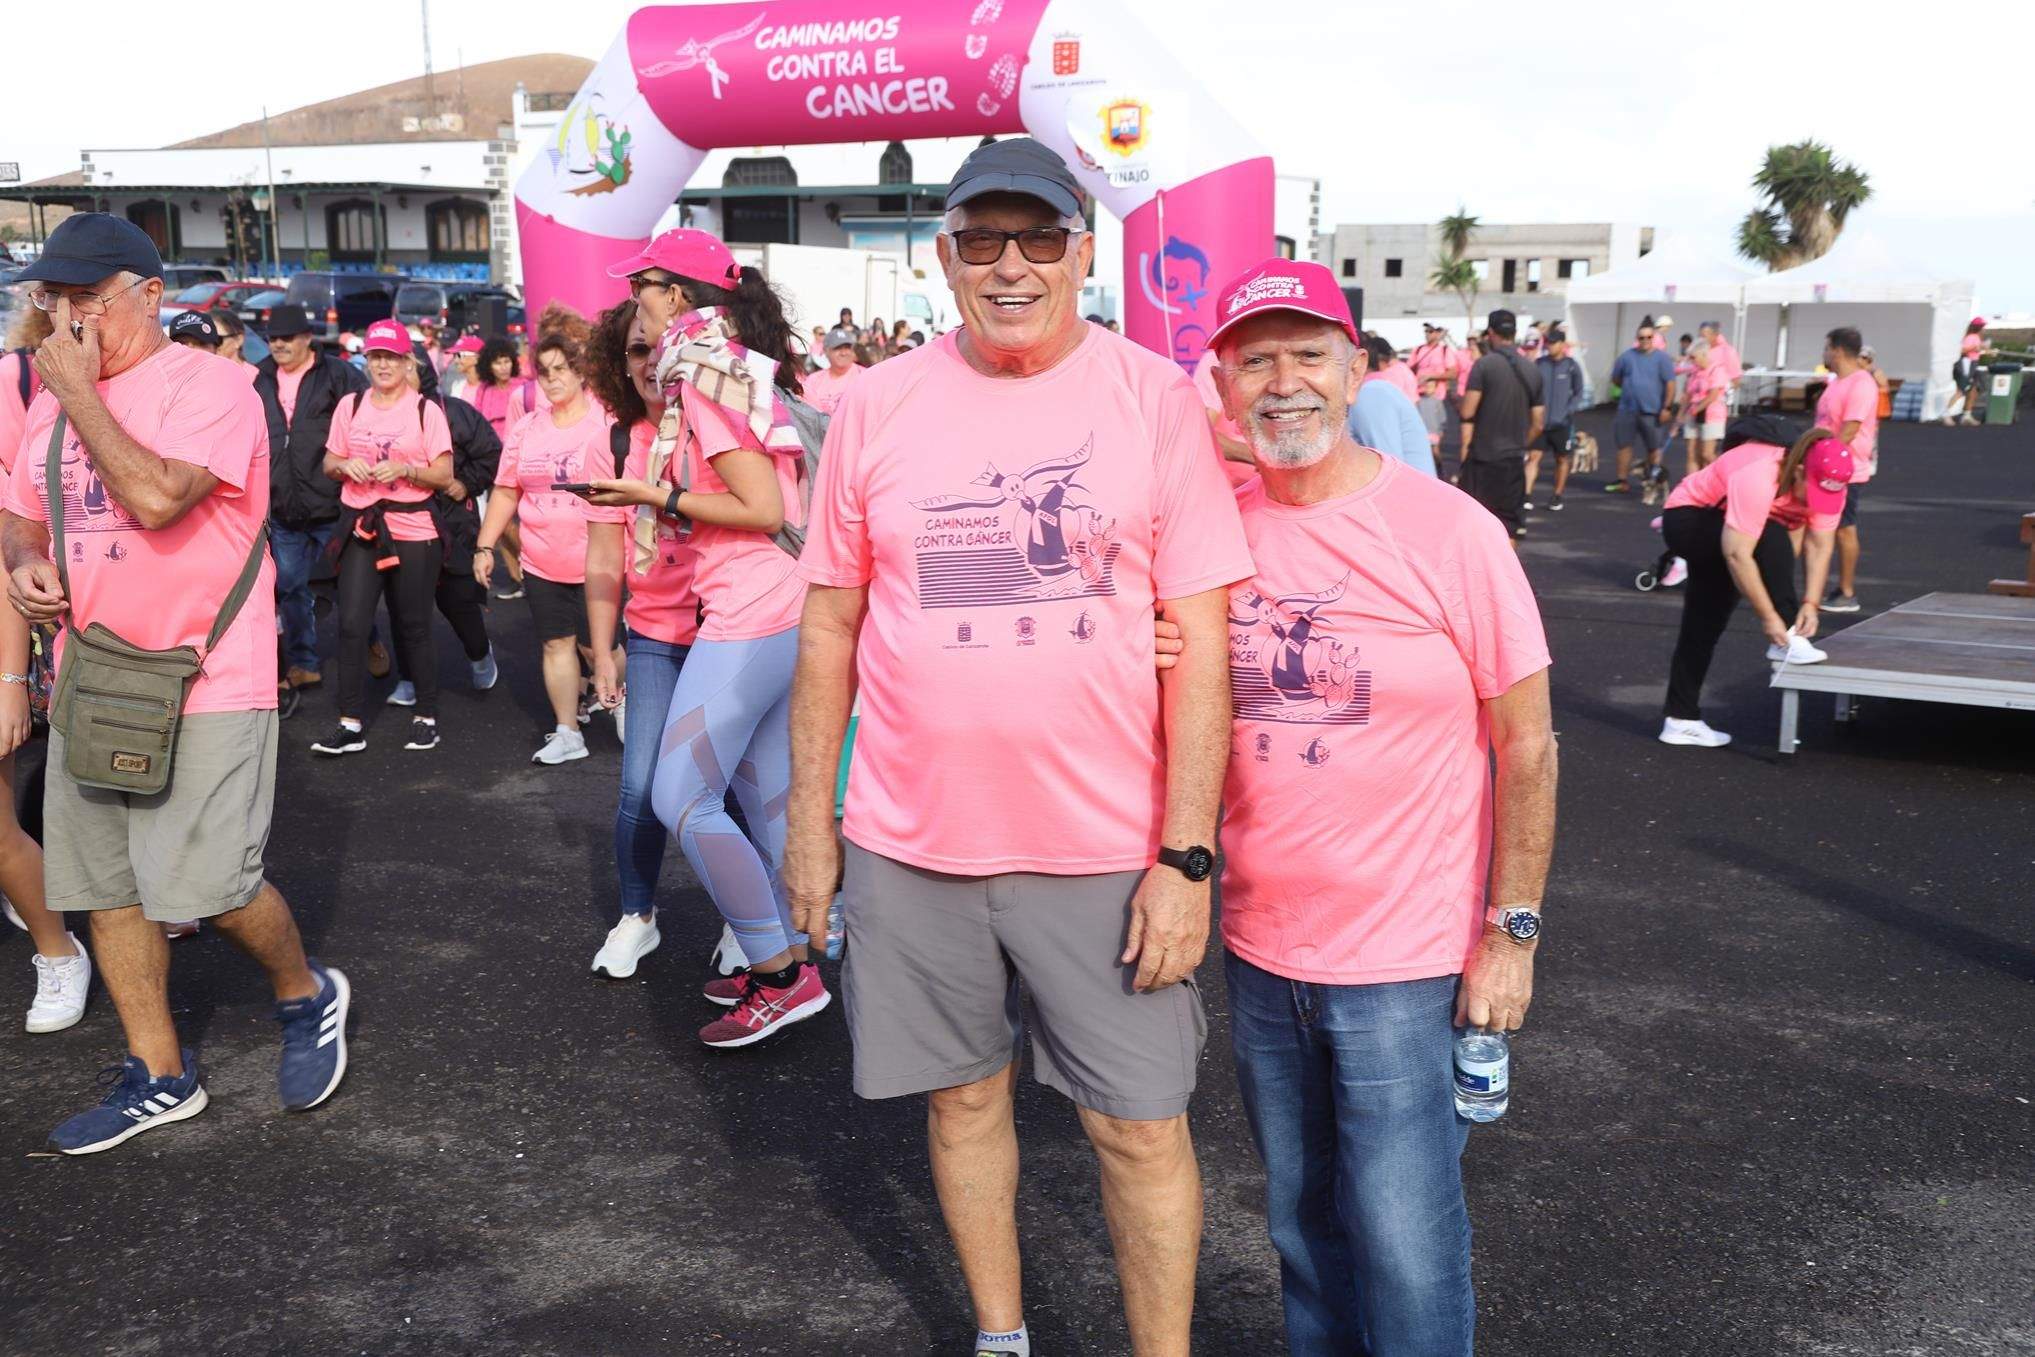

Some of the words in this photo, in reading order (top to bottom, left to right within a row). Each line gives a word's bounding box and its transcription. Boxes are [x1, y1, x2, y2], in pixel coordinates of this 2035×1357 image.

[755, 16, 901, 50] CAMINAMOS
[767, 50, 867, 81] CONTRA
[874, 47, 905, 74] EL
[806, 76, 955, 119] CANCER
[925, 516, 1000, 531] CAMINAMOS
[914, 534, 963, 549] CONTRA
